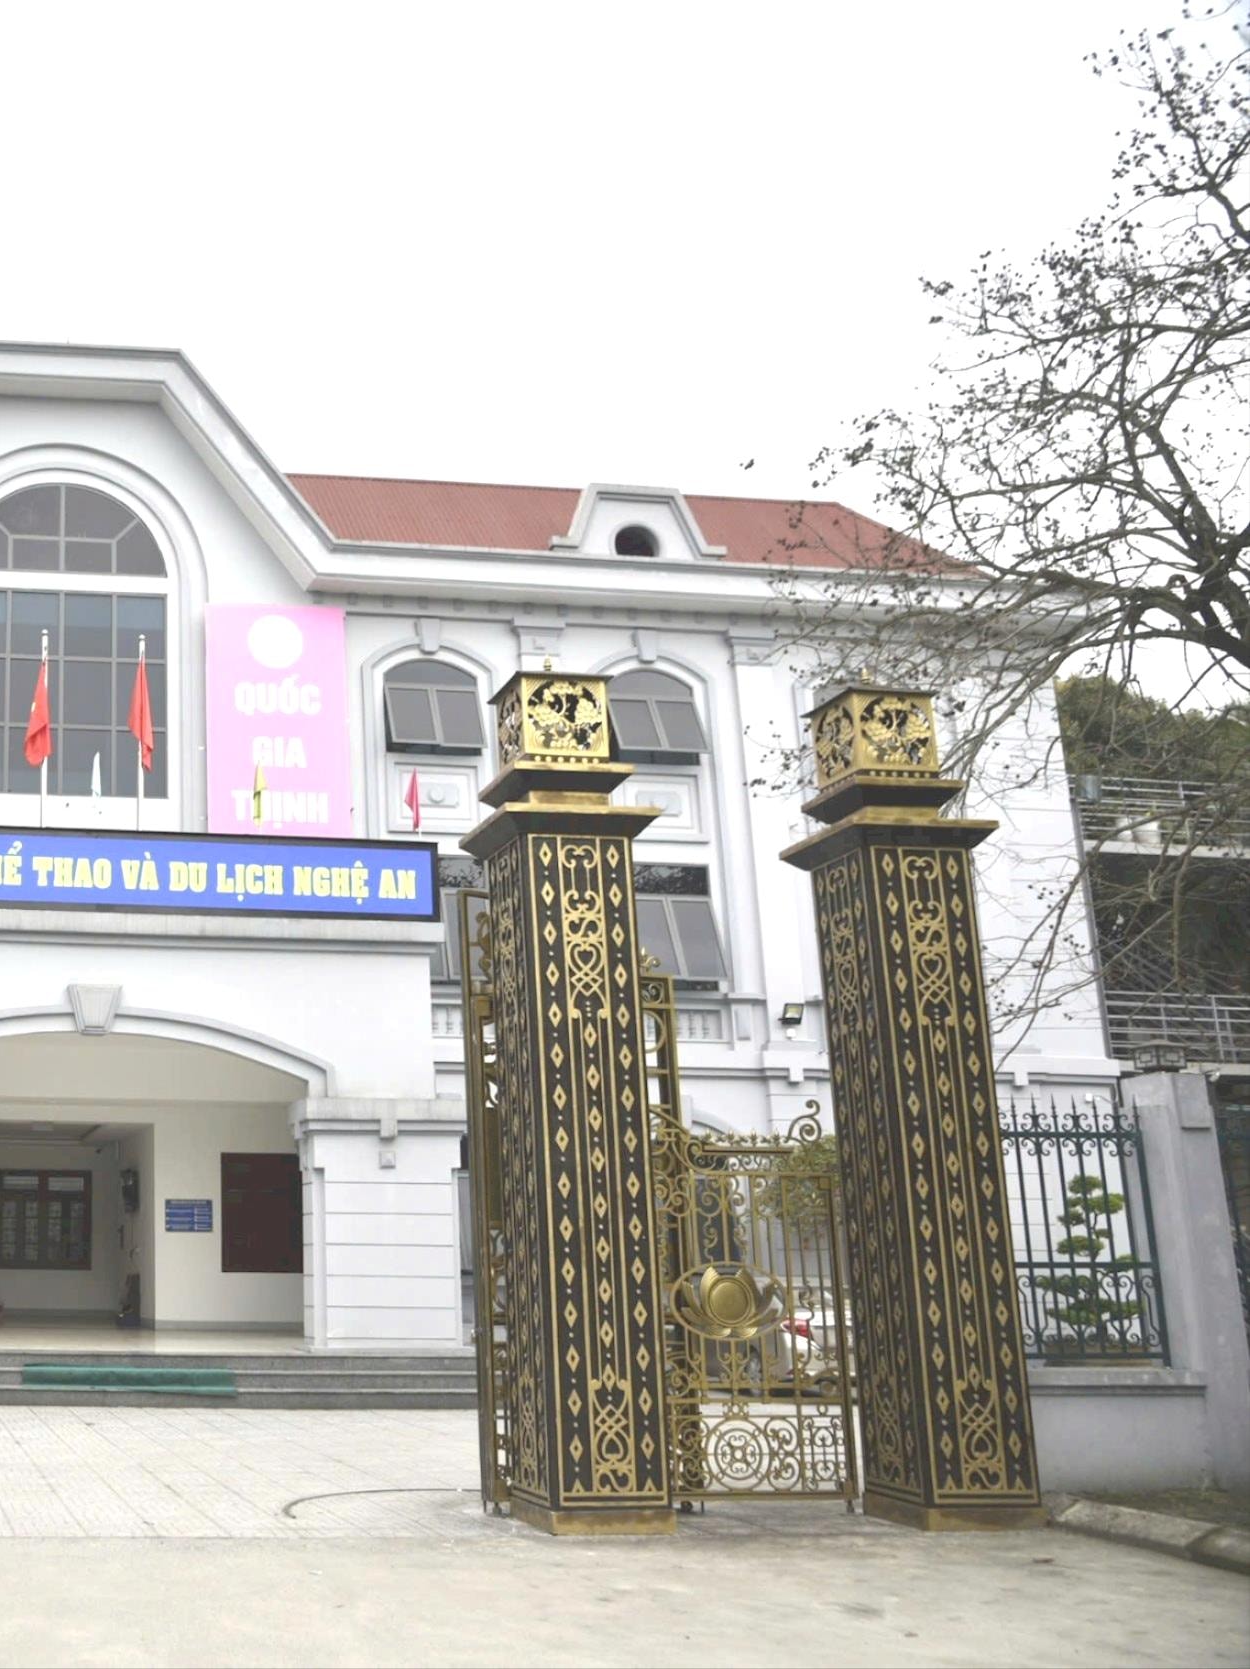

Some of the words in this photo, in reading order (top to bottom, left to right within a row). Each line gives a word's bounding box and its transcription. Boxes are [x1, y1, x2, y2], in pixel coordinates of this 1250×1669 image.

[234, 674, 322, 716] QUỐC
[253, 735, 308, 768] GIA
[32, 855, 112, 889] THAO
[120, 851, 159, 891] VÀ
[168, 861, 208, 893] DU
[216, 863, 284, 901] LỊCH
[292, 860, 369, 904] NGHỆ
[378, 868, 417, 900] AN
